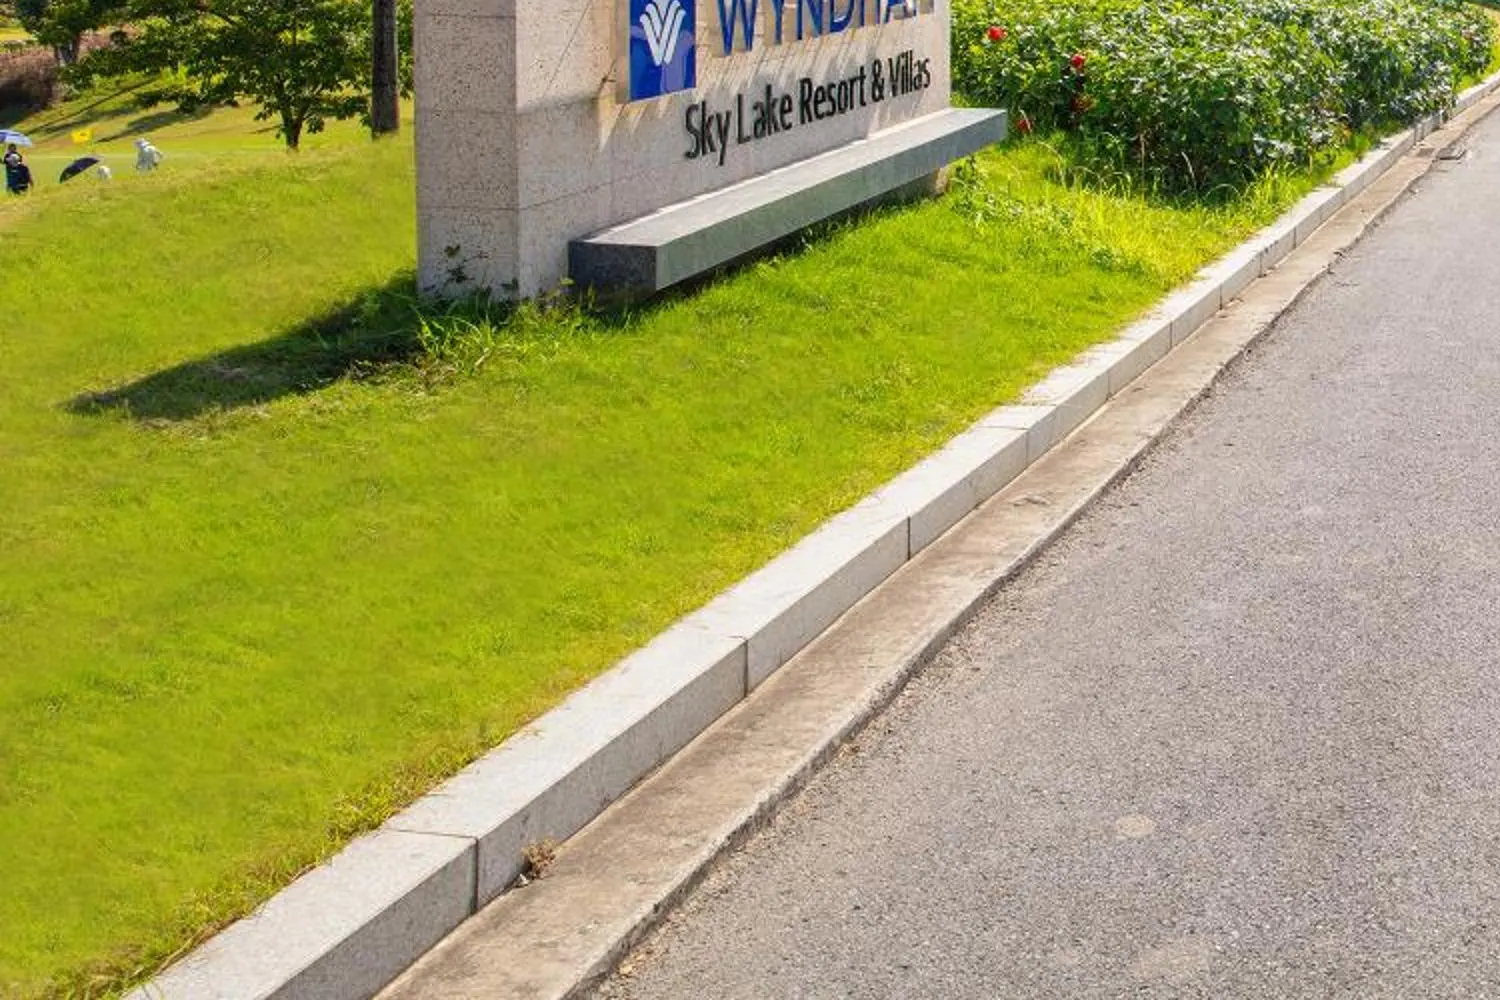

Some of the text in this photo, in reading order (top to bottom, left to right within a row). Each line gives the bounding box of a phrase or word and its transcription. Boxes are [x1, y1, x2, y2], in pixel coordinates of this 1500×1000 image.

[685, 50, 931, 166] Sky Lake Resort & Villas
